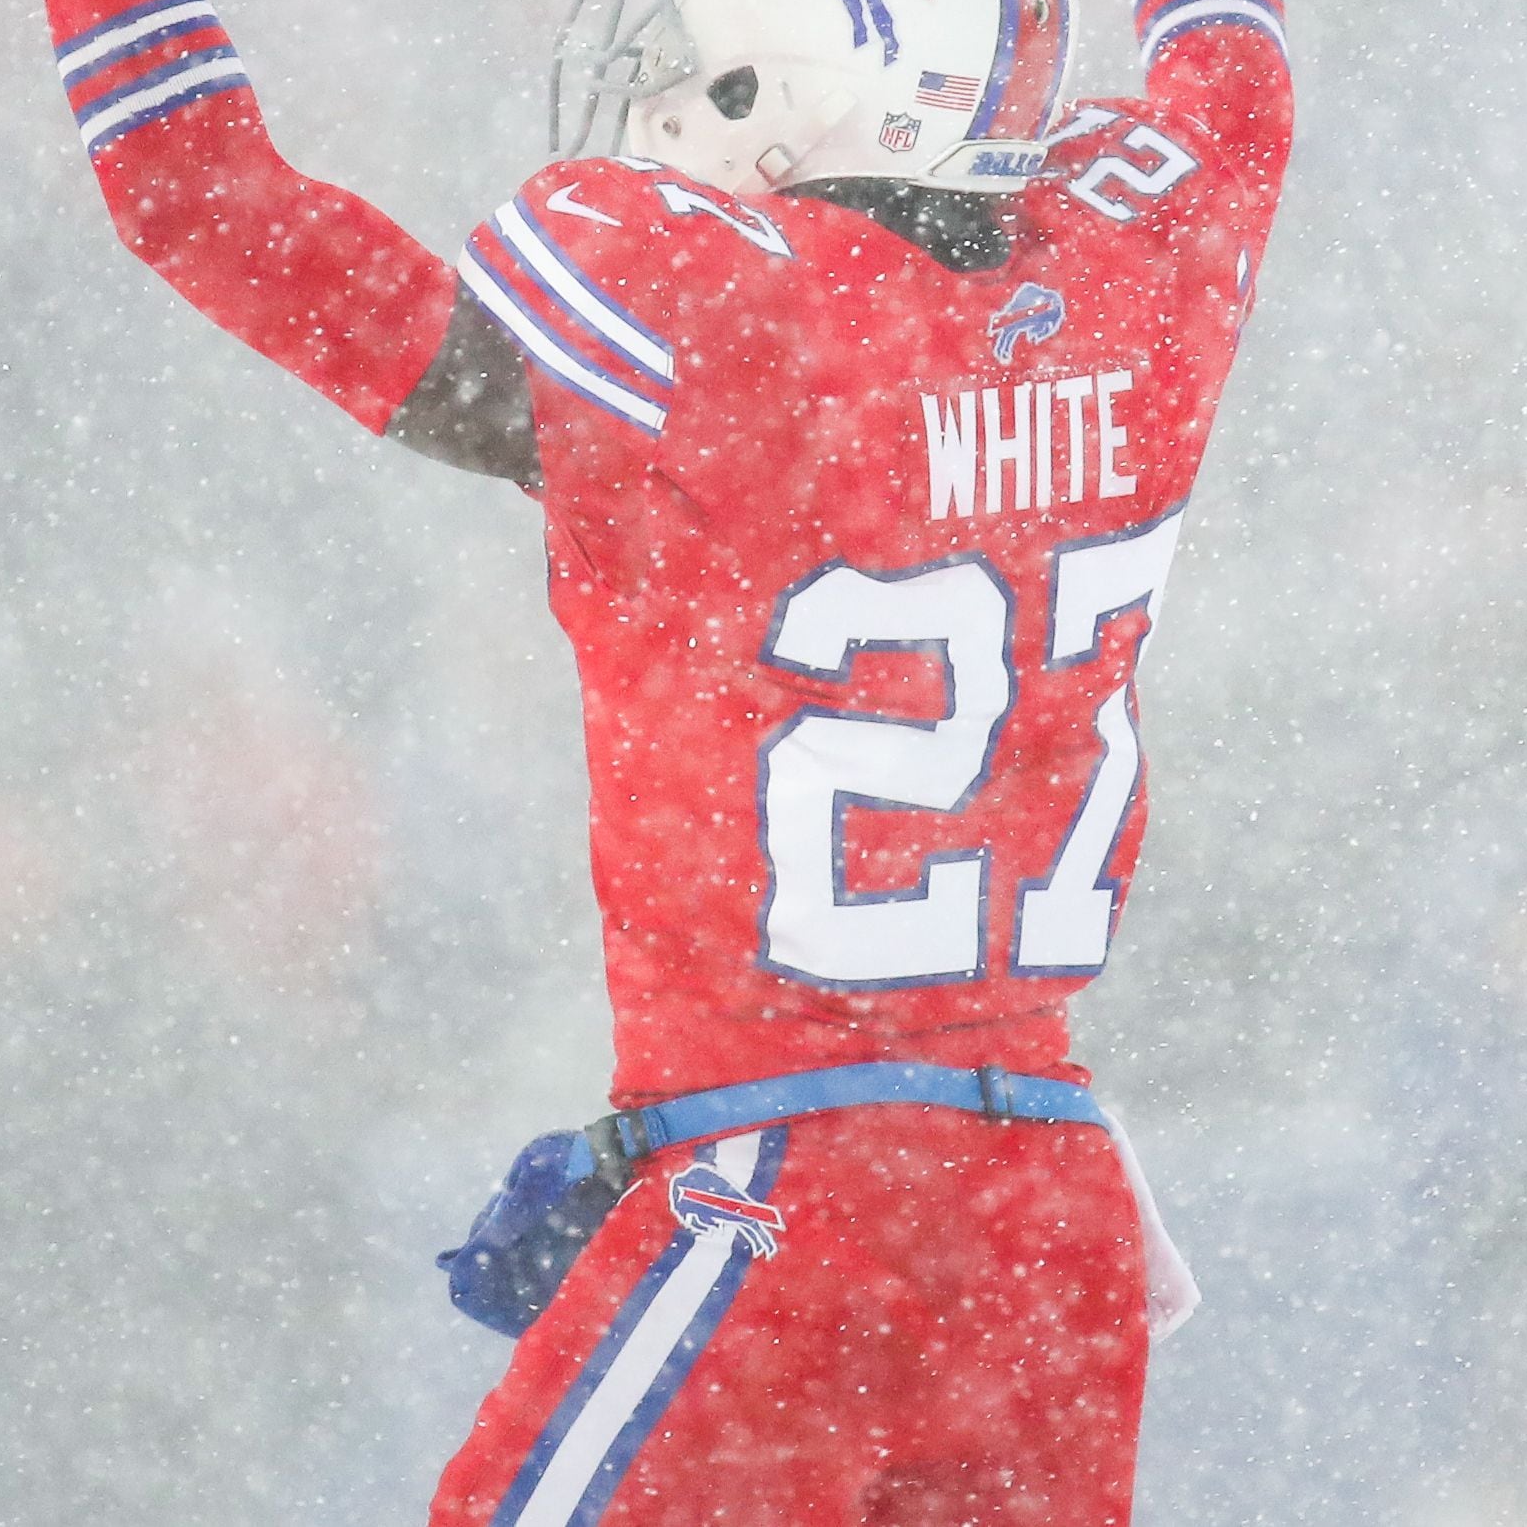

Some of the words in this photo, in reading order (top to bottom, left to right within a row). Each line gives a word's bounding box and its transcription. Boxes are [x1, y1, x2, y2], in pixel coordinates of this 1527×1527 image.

[882, 126, 914, 150] NFL
[921, 369, 1137, 521] WHITE
[756, 498, 1188, 992] 27
